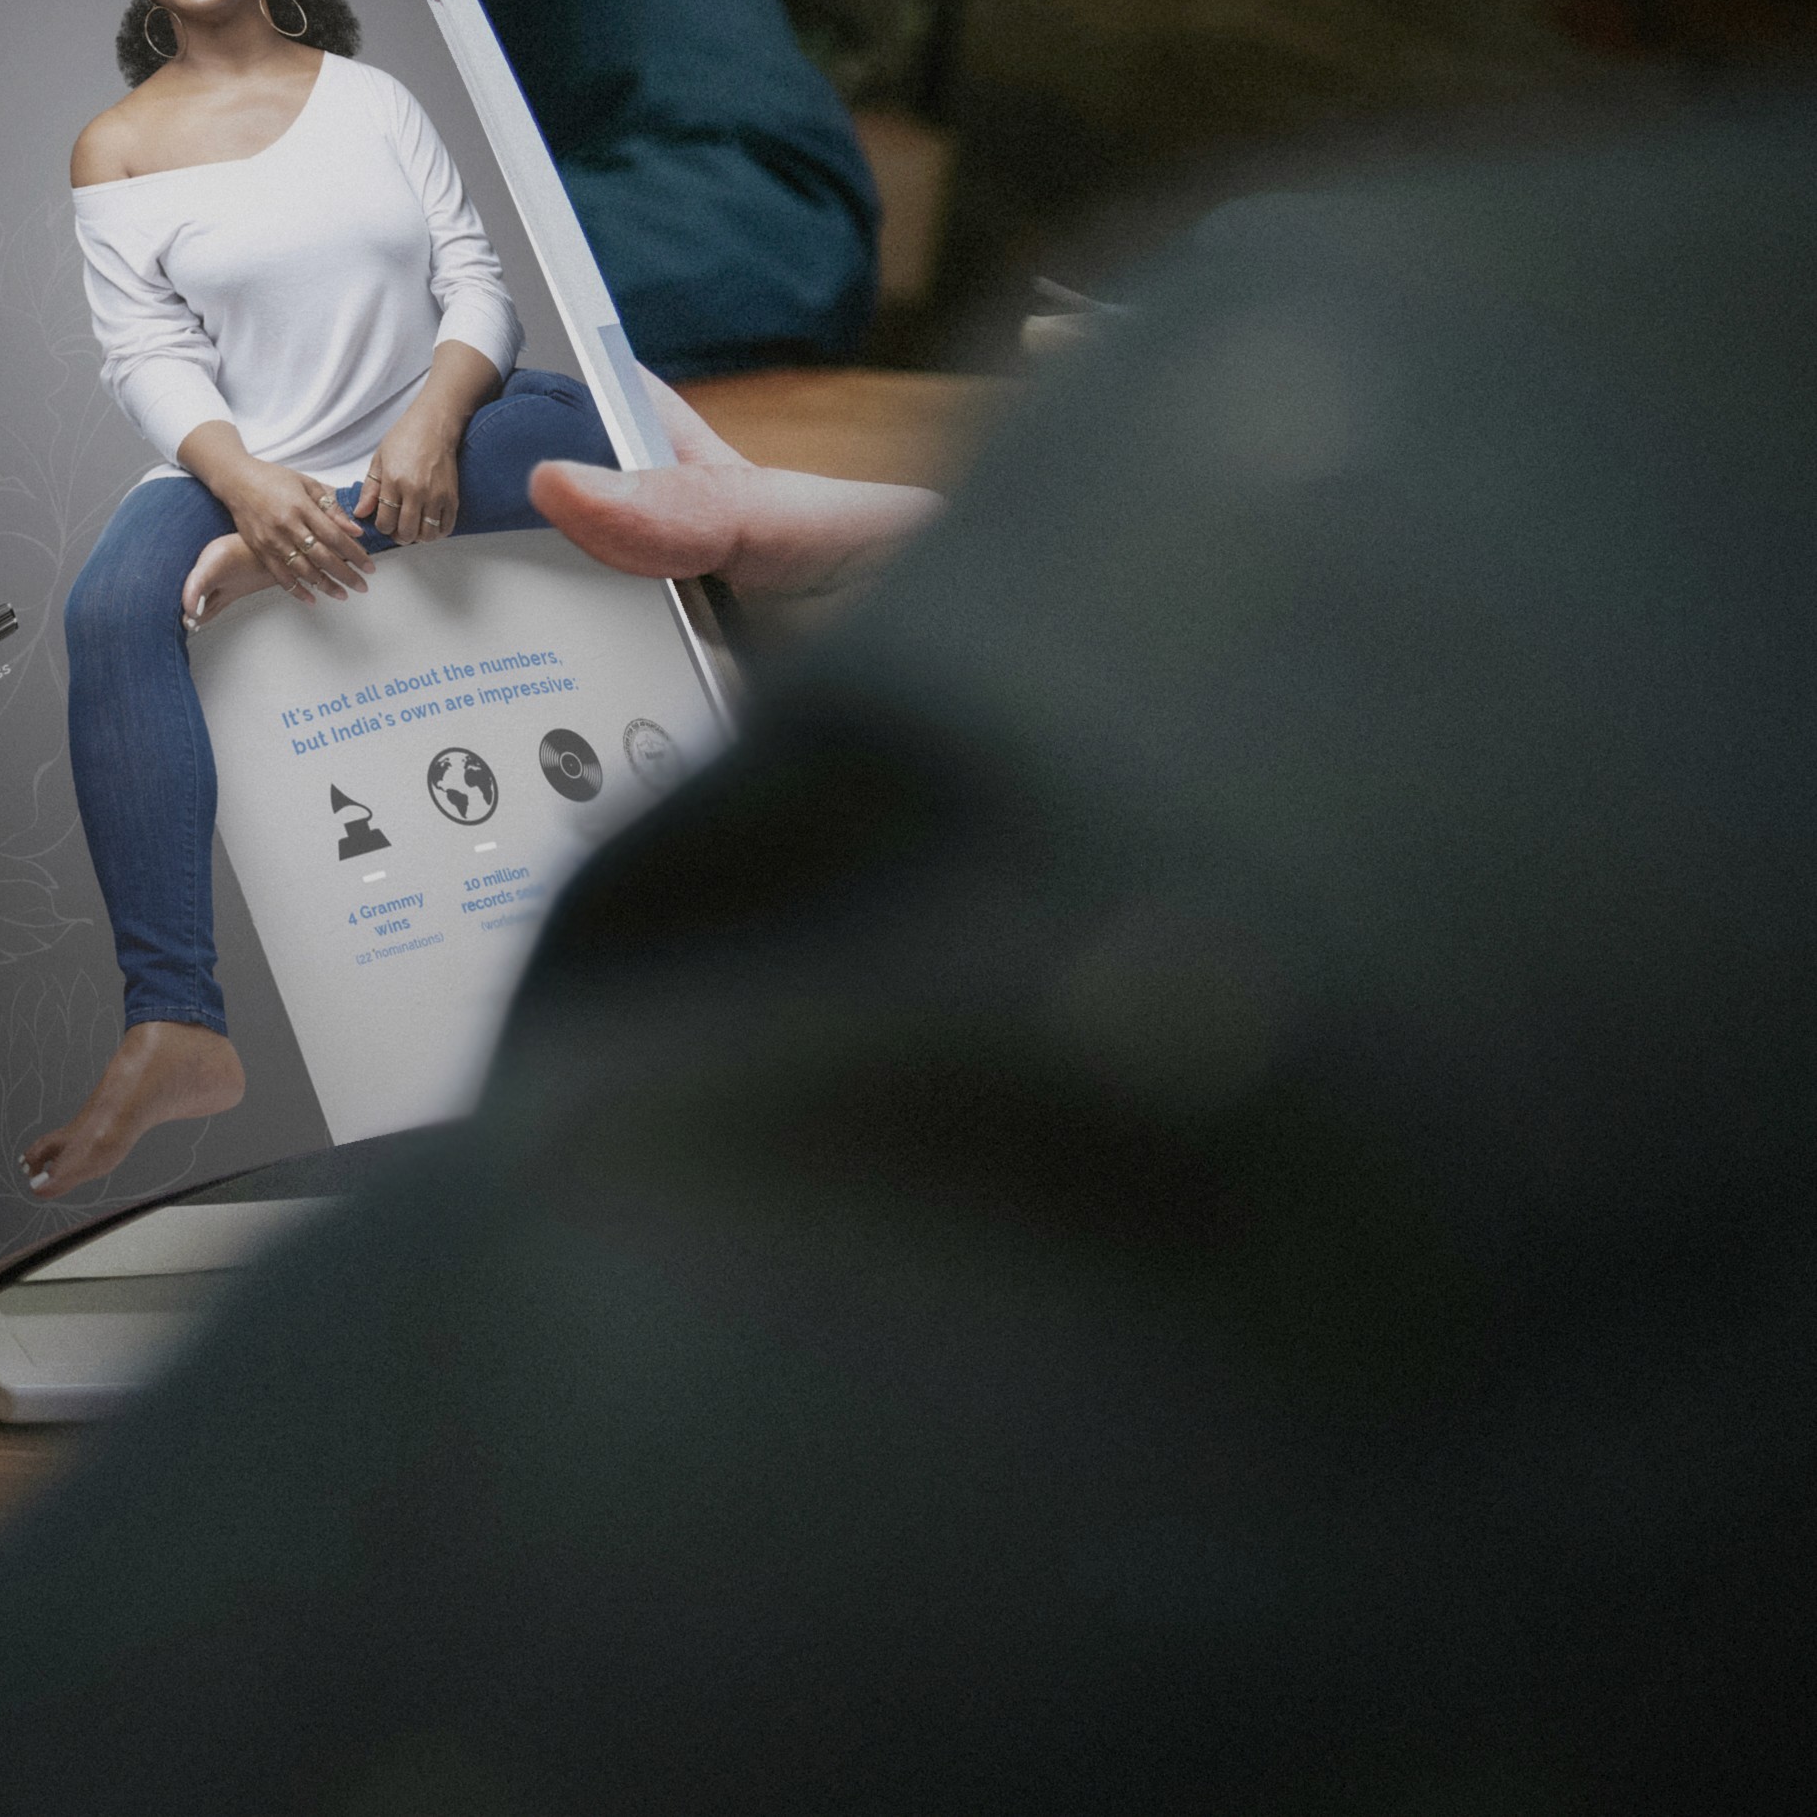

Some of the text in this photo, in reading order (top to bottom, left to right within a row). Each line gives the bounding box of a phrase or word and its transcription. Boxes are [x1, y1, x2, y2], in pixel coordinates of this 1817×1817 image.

[317, 692, 353, 717] not
[355, 685, 382, 705] all
[384, 668, 442, 698] about
[443, 662, 475, 682] the
[479, 649, 564, 676] numbers,
[292, 731, 329, 756] but
[400, 700, 442, 723] own
[445, 689, 475, 711] are
[477, 674, 580, 705] impressive:
[463, 865, 530, 892] 10 million
[348, 891, 425, 926] 4 Grammy
[461, 889, 514, 914] records
[374, 916, 411, 937] wins
[374, 932, 445, 960] nominations)
